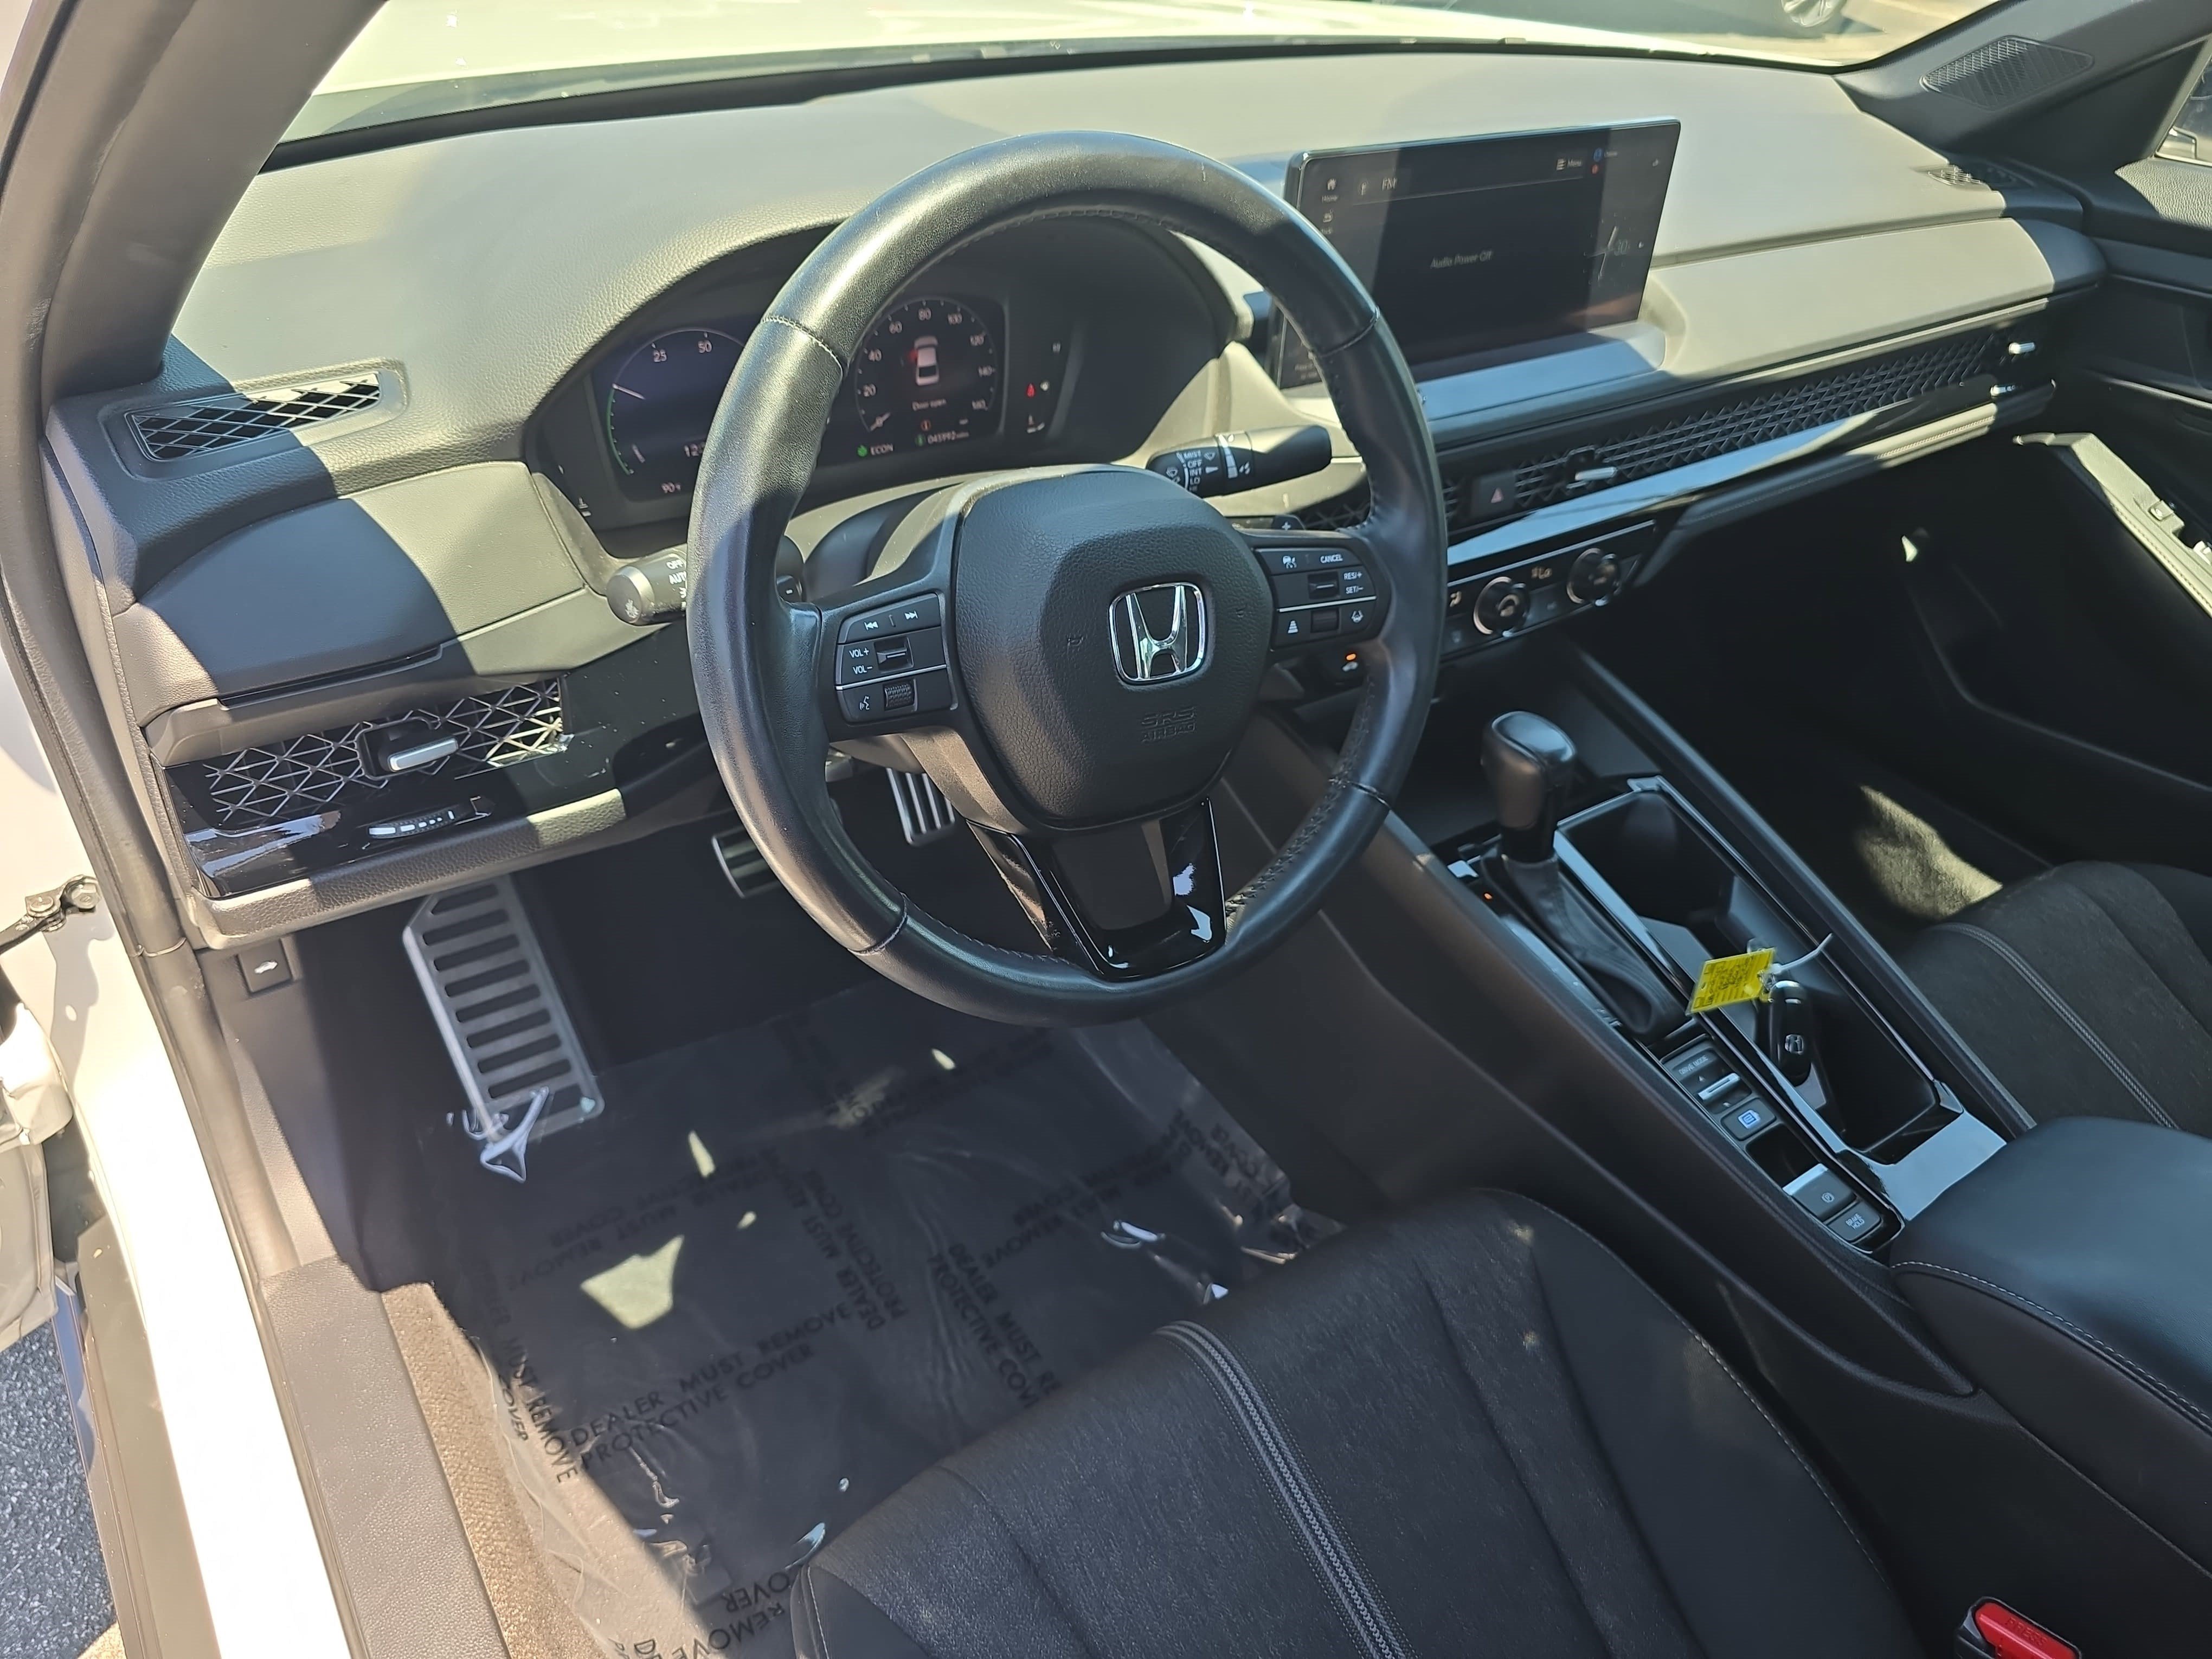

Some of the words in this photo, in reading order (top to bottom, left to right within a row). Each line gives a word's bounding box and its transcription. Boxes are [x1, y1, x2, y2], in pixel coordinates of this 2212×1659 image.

[1454, 254, 1478, 265] Power
[918, 307, 931, 320] 80
[889, 321, 902, 334] 60
[698, 340, 712, 353] 50
[653, 349, 667, 362] 25
[869, 349, 882, 362] 40
[863, 383, 876, 397] 20
[870, 443, 893, 455] ECON
[1187, 459, 1202, 468] OFF
[666, 560, 684, 569] OFF
[1320, 554, 1343, 564] CANCEL
[836, 1265, 886, 1332] DEALER
[949, 1243, 999, 1306] DEALER
[995, 1310, 1043, 1363] MUST
[571, 1391, 665, 1446] DEALER
[678, 1351, 745, 1393] MUST
[756, 1302, 853, 1355] REMOVE
[581, 1382, 729, 1470] PROTECTIVE
[735, 1342, 815, 1390] COVER
[529, 1395, 579, 1484] REMOVE
